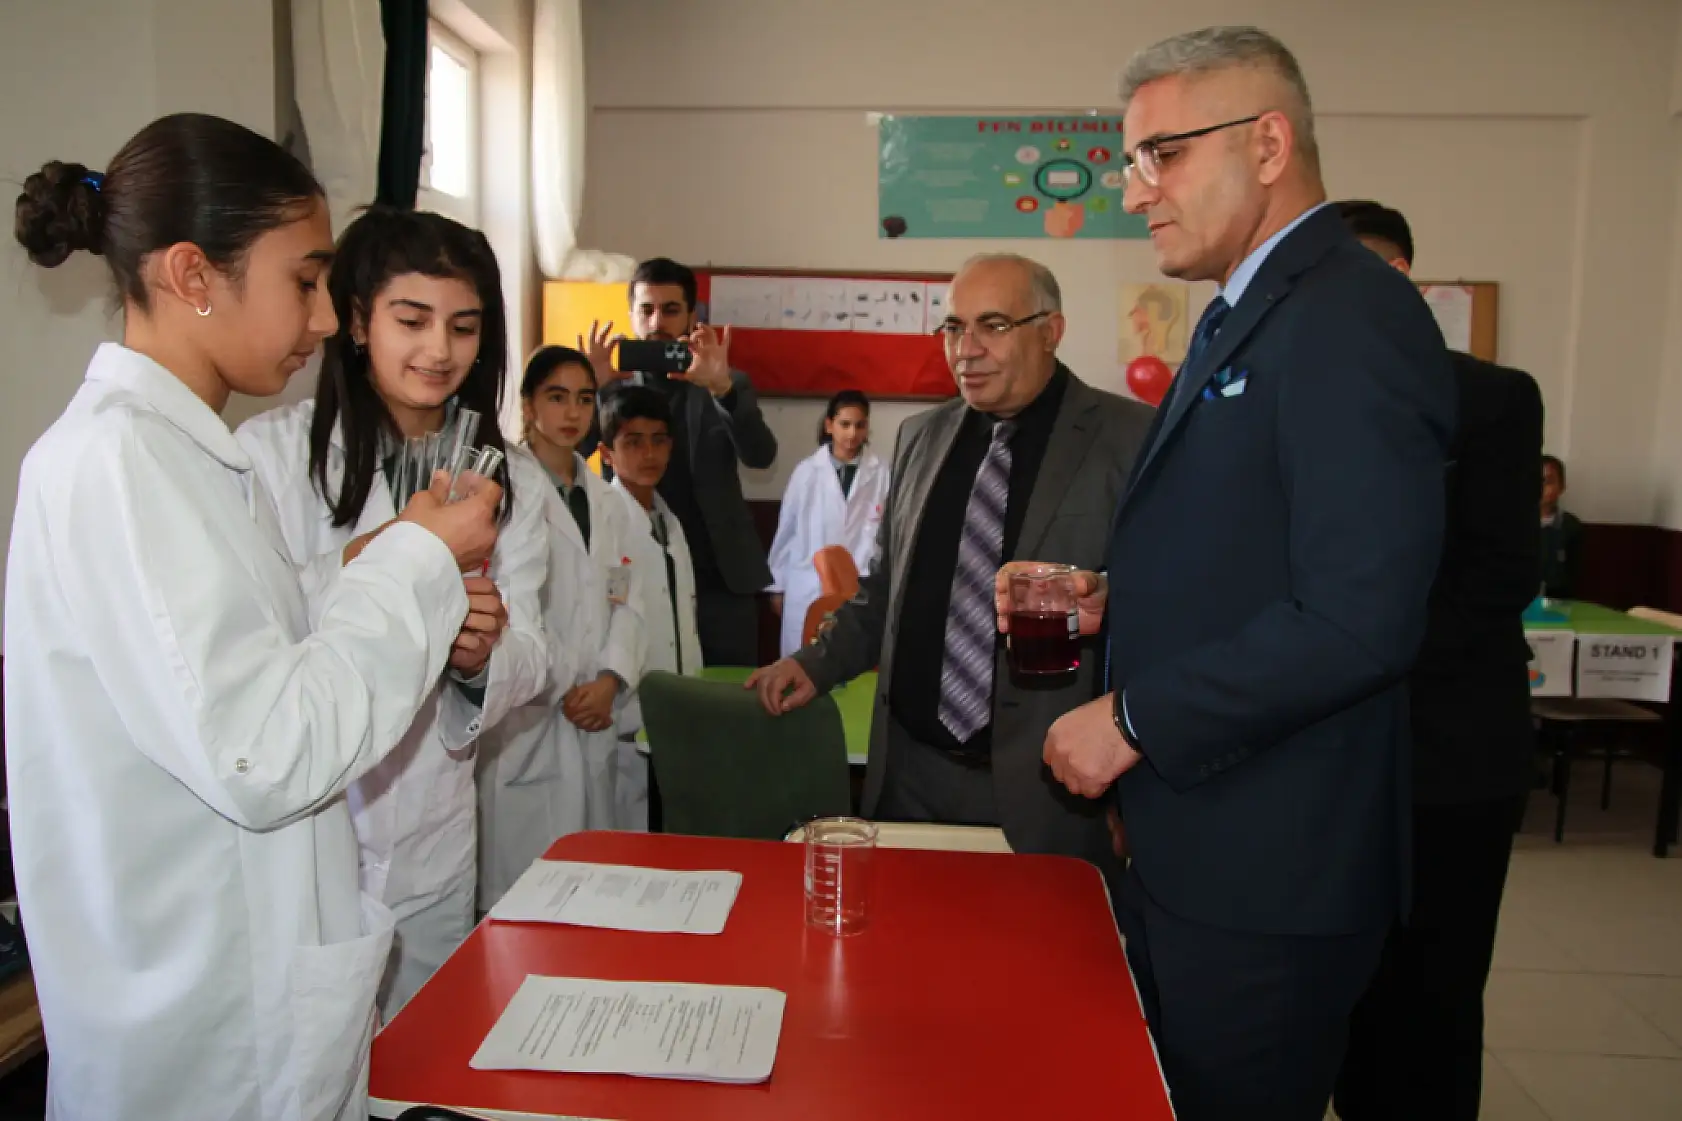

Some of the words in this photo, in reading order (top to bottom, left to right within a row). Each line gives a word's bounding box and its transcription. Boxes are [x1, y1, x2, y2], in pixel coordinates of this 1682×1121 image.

[977, 119, 1021, 133] FEN
[1591, 644, 1647, 659] STAND
[1651, 645, 1659, 660] 1
